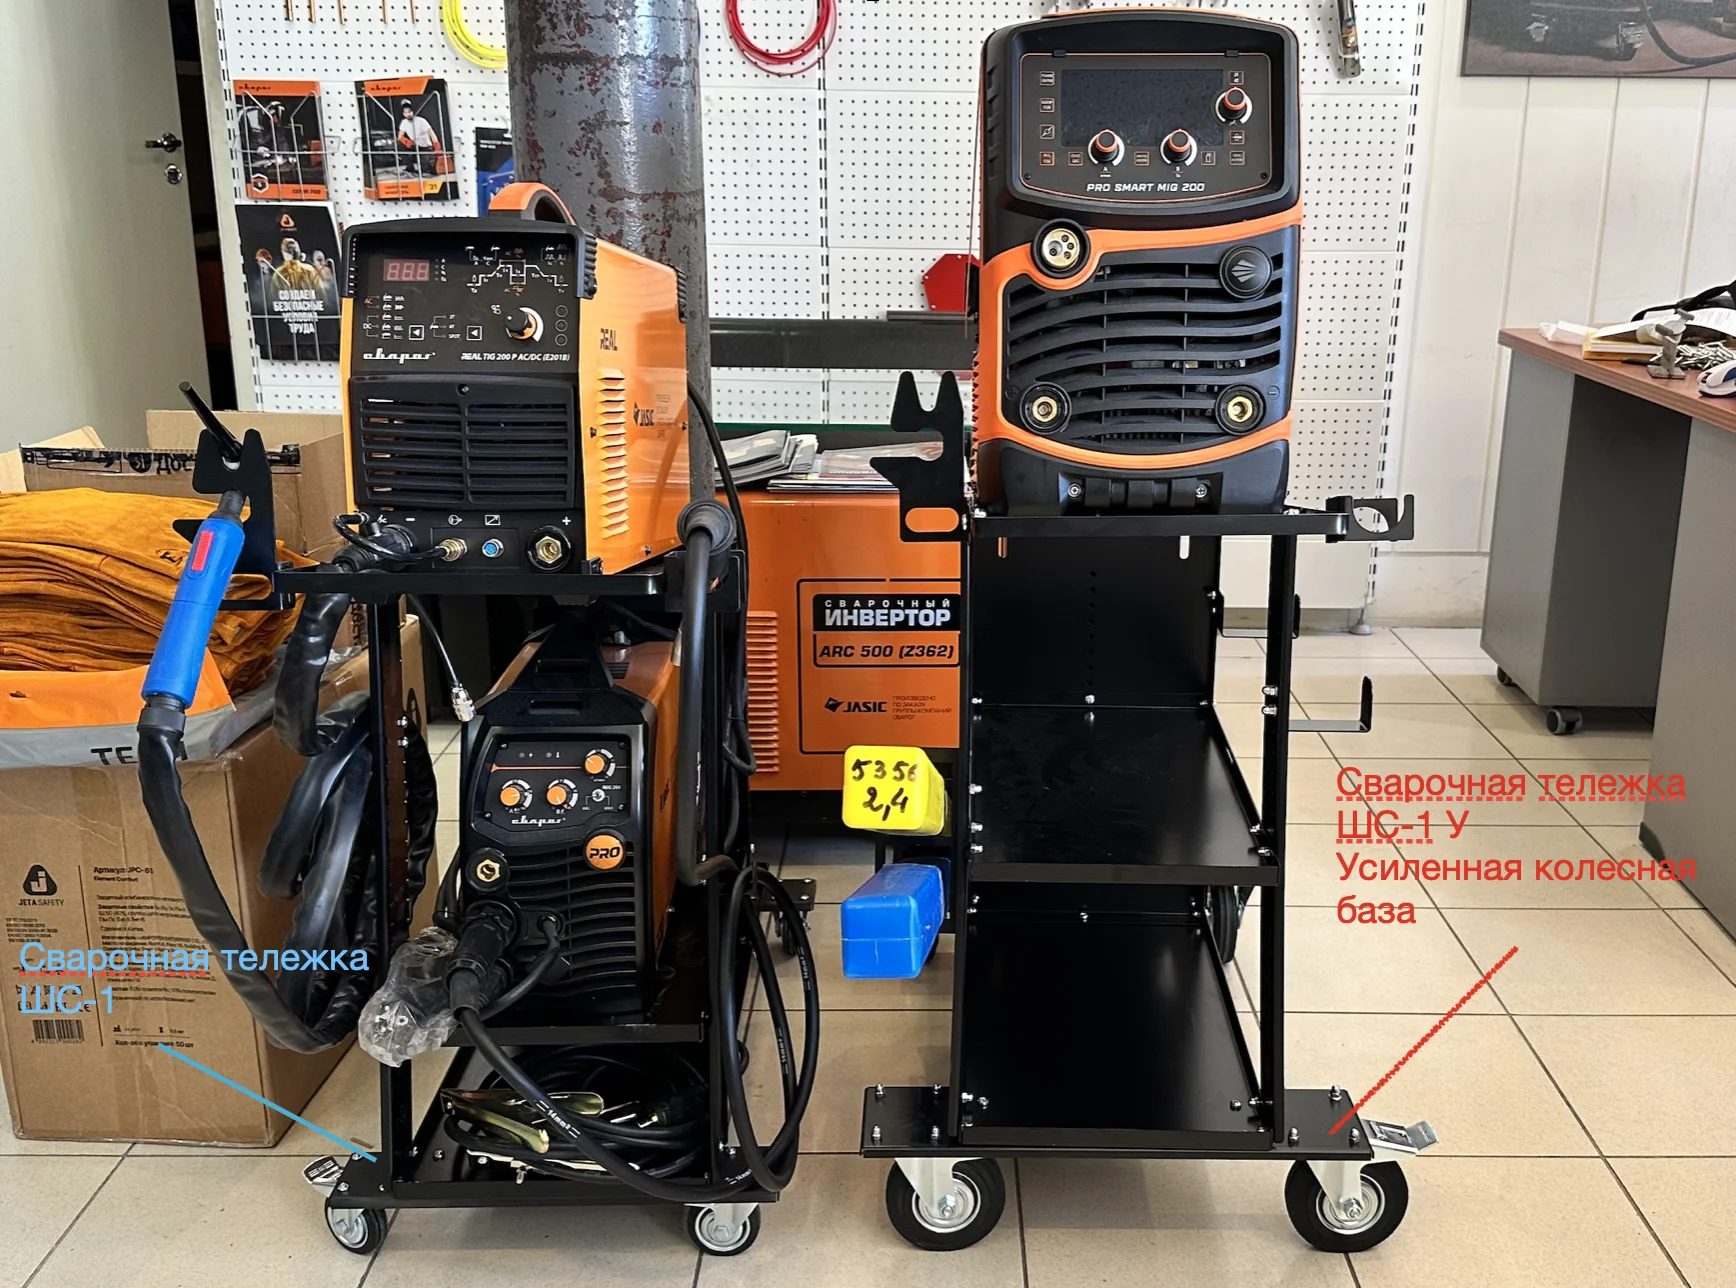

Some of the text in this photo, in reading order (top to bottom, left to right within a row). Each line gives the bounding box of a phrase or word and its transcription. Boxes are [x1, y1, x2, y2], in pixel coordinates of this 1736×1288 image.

[1086, 183, 1205, 192] PRO SMART MIG 200
[460, 352, 482, 360] REAL
[482, 352, 496, 360] TIG
[496, 352, 511, 360] 200
[518, 352, 542, 361] AC/DC
[542, 353, 570, 362] (E201B)
[824, 598, 950, 608] СВАРОЧНЫЙ
[825, 608, 951, 626] ИНВЕРТОР
[820, 645, 954, 660] ARC 500 (Z362)
[842, 701, 887, 713] JASIC
[862, 786, 909, 822] 2,4
[589, 846, 621, 860] PRO
